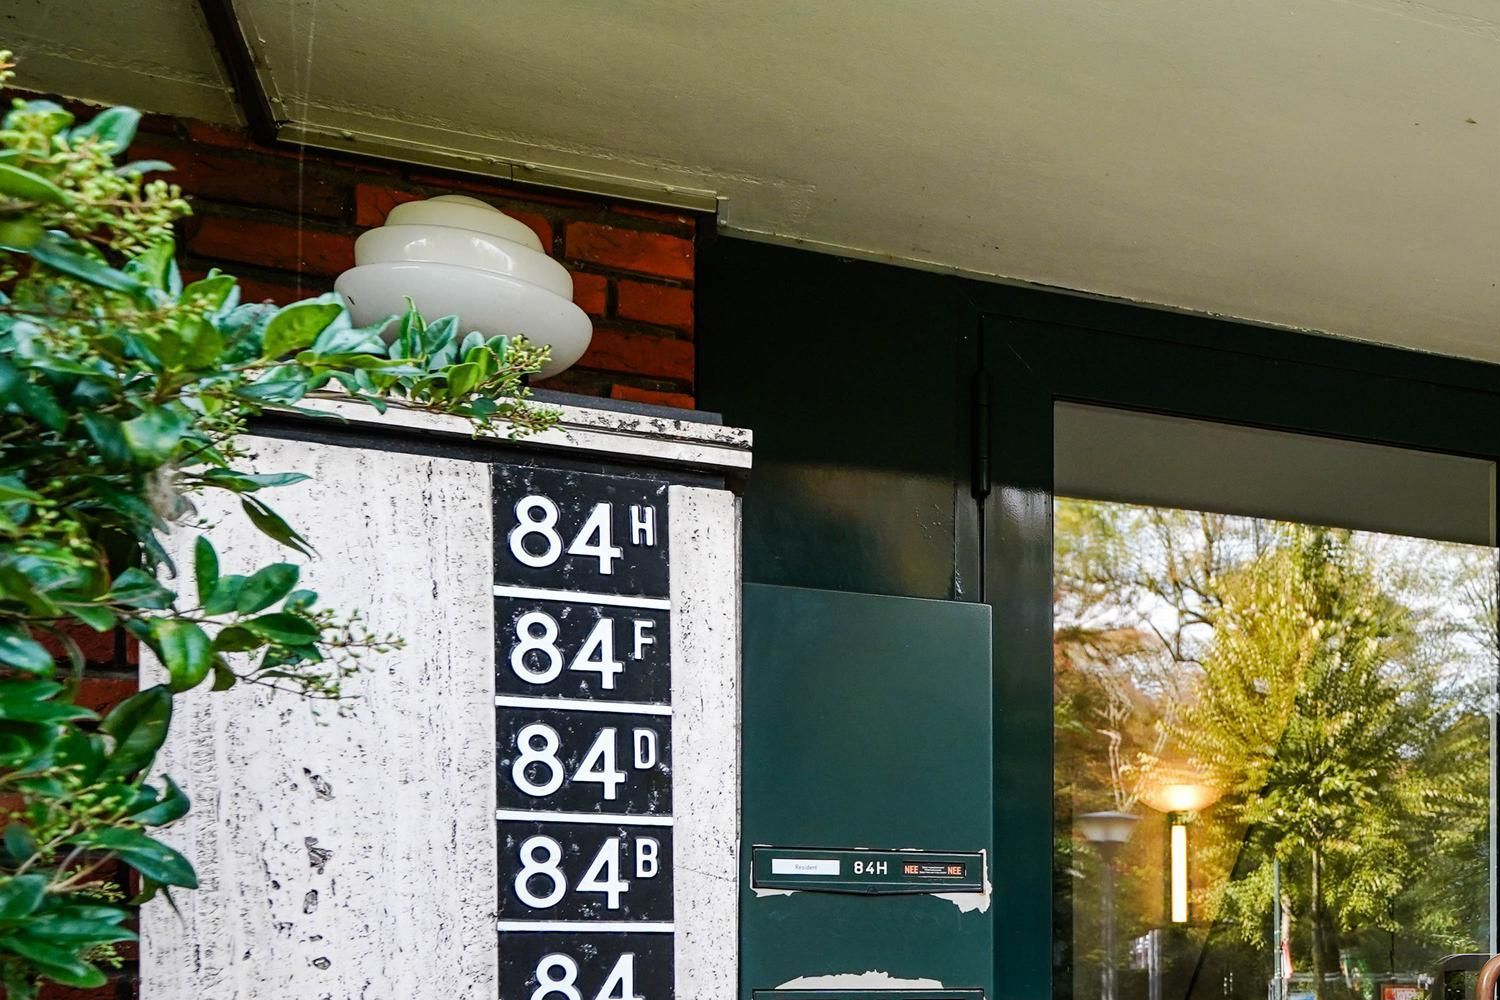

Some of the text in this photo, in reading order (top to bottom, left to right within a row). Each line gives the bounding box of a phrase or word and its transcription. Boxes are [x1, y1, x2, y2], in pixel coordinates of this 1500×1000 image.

[509, 494, 655, 575] 84H
[511, 611, 654, 690] 84F
[512, 723, 657, 800] 84D
[514, 835, 660, 910] 84B
[795, 863, 818, 872] Resident
[854, 861, 887, 875] 84H
[904, 865, 919, 874] NEE
[947, 866, 962, 875] NEE
